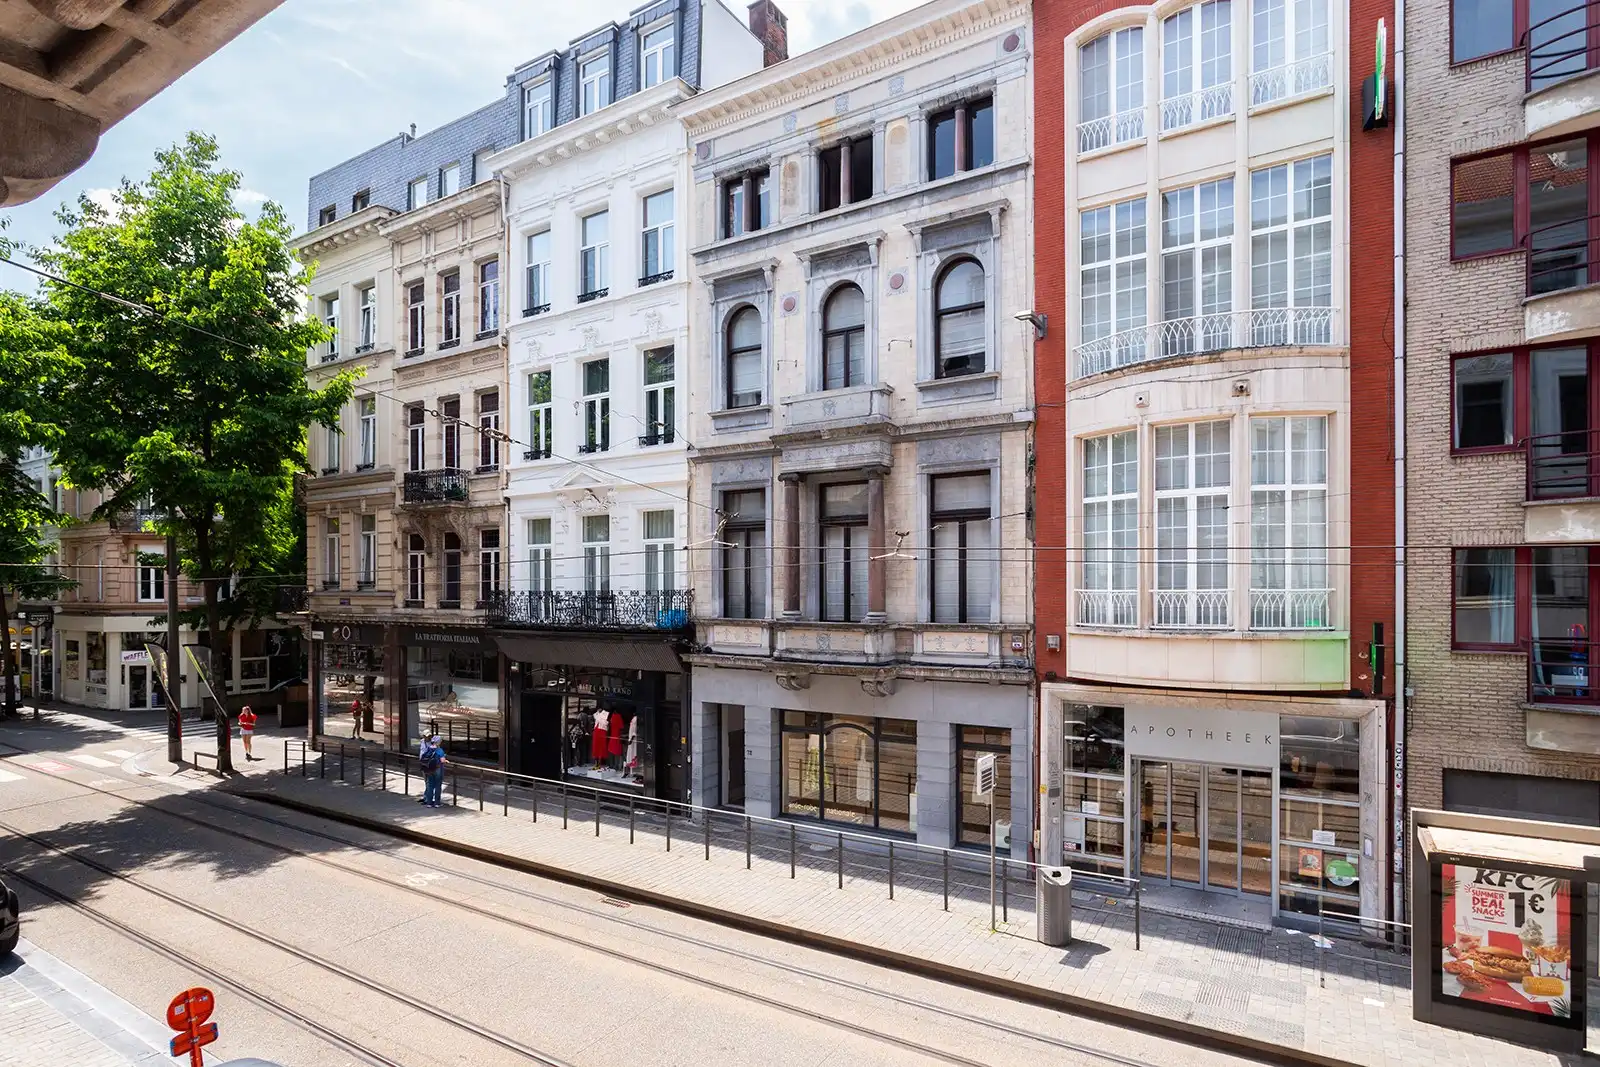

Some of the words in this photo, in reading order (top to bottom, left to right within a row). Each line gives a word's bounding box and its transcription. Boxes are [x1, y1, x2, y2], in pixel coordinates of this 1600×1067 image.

[415, 632, 423, 641] LA
[453, 634, 481, 644] ITALIANA
[1130, 725, 1272, 745] APOTHEEK
[1473, 868, 1536, 891] KFC
[1471, 889, 1505, 900] SUMMER
[1472, 896, 1505, 910] DEAL
[1471, 906, 1505, 918] SNACKS
